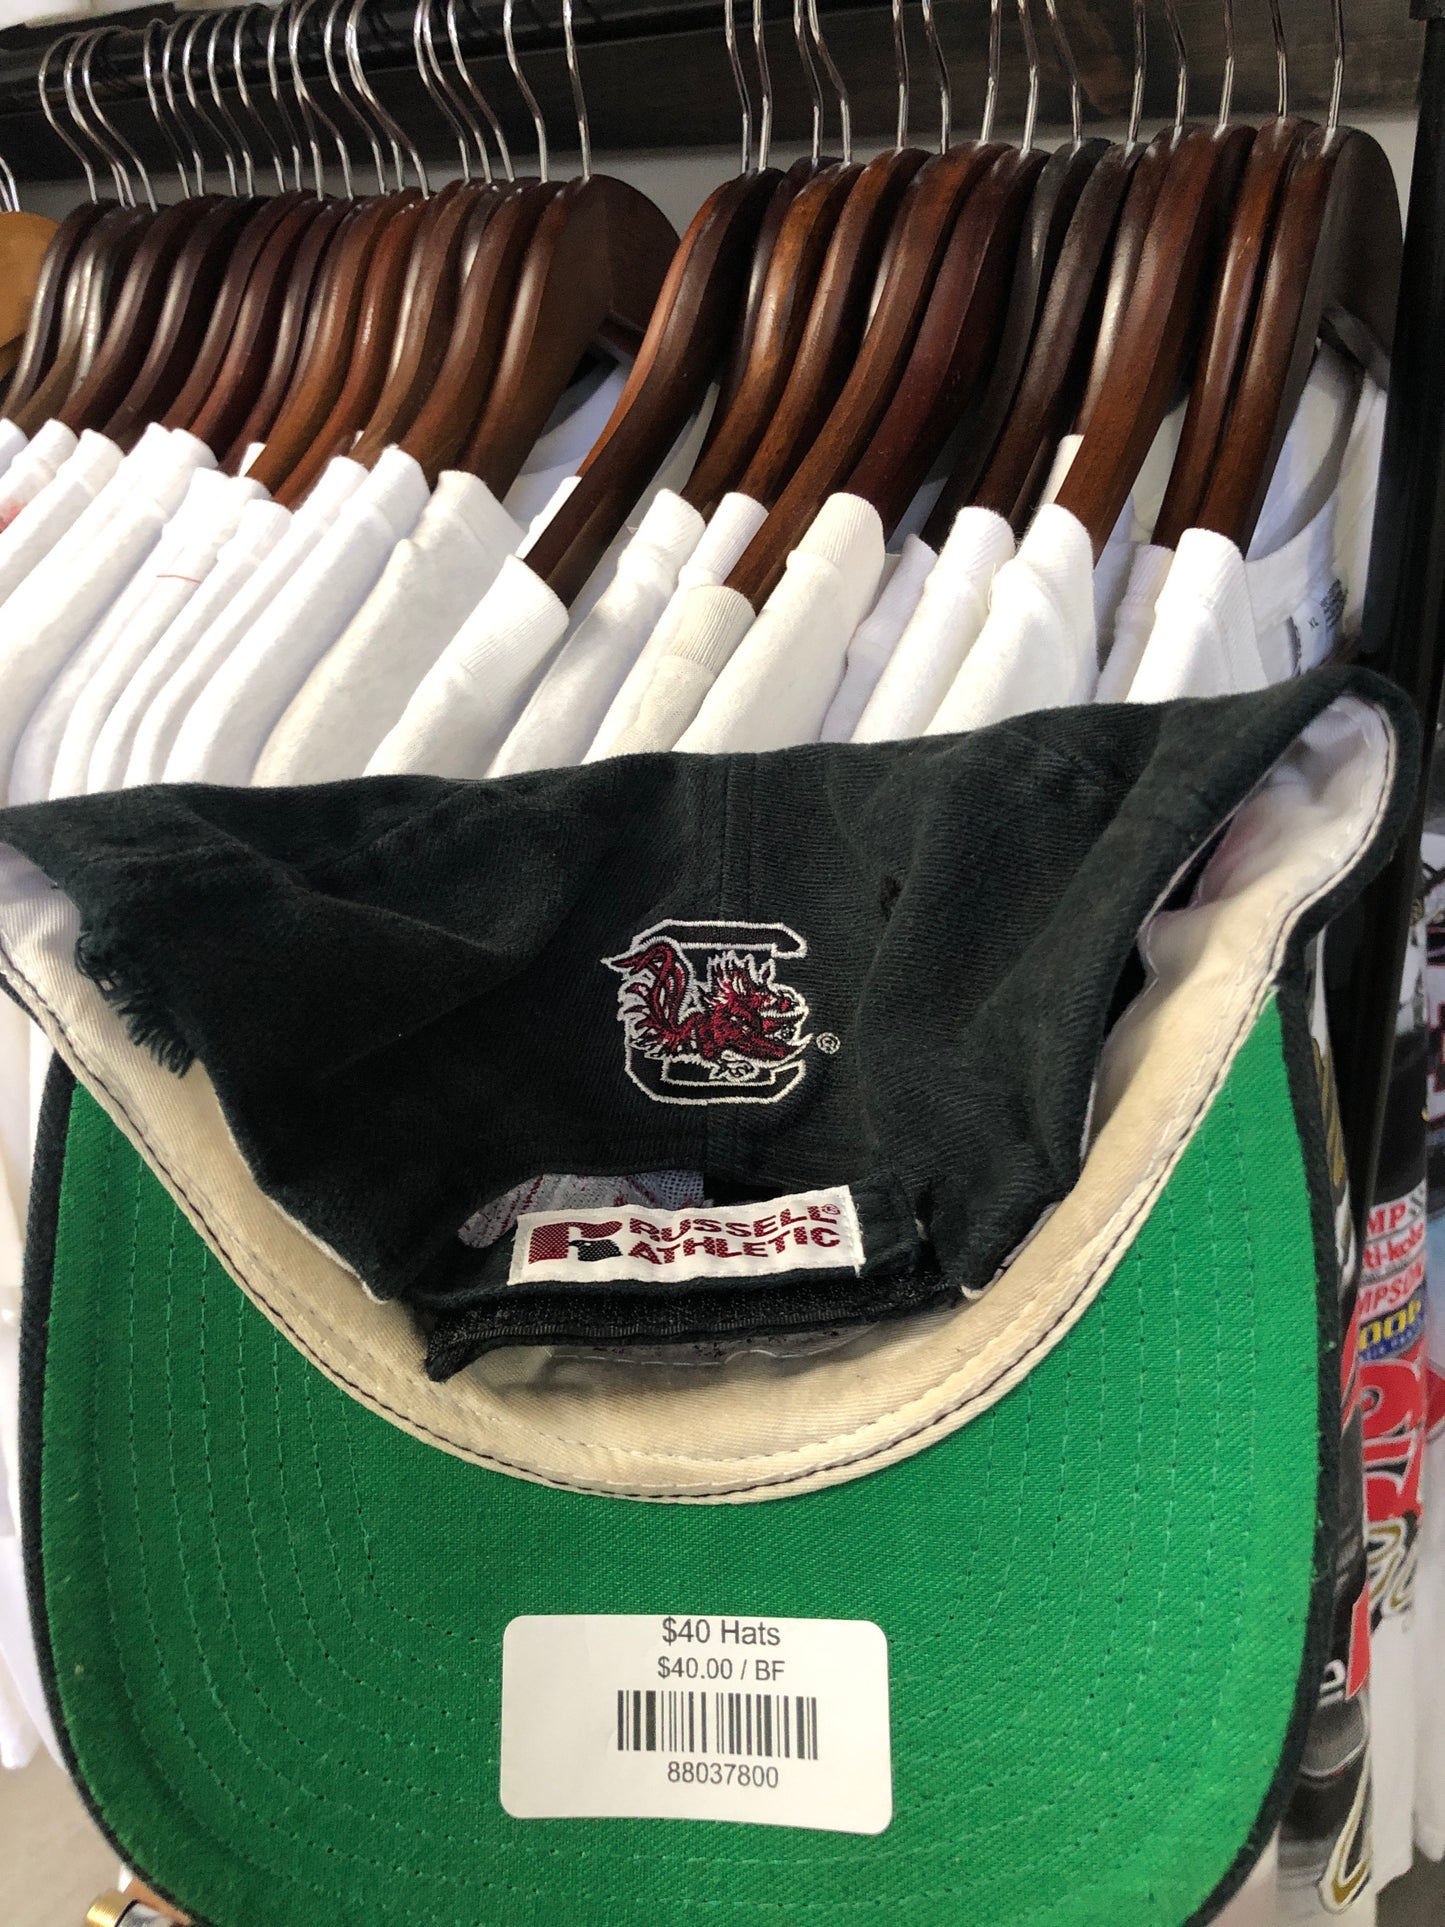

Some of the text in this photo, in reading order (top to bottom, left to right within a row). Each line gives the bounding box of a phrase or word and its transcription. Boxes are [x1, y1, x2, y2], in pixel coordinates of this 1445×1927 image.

[628, 1226, 841, 1265] ATHLETIC
[662, 1616, 781, 1646] $40 Hats
[657, 1655, 786, 1682] $40.00 / BF
[667, 1761, 780, 1789] 88037800
